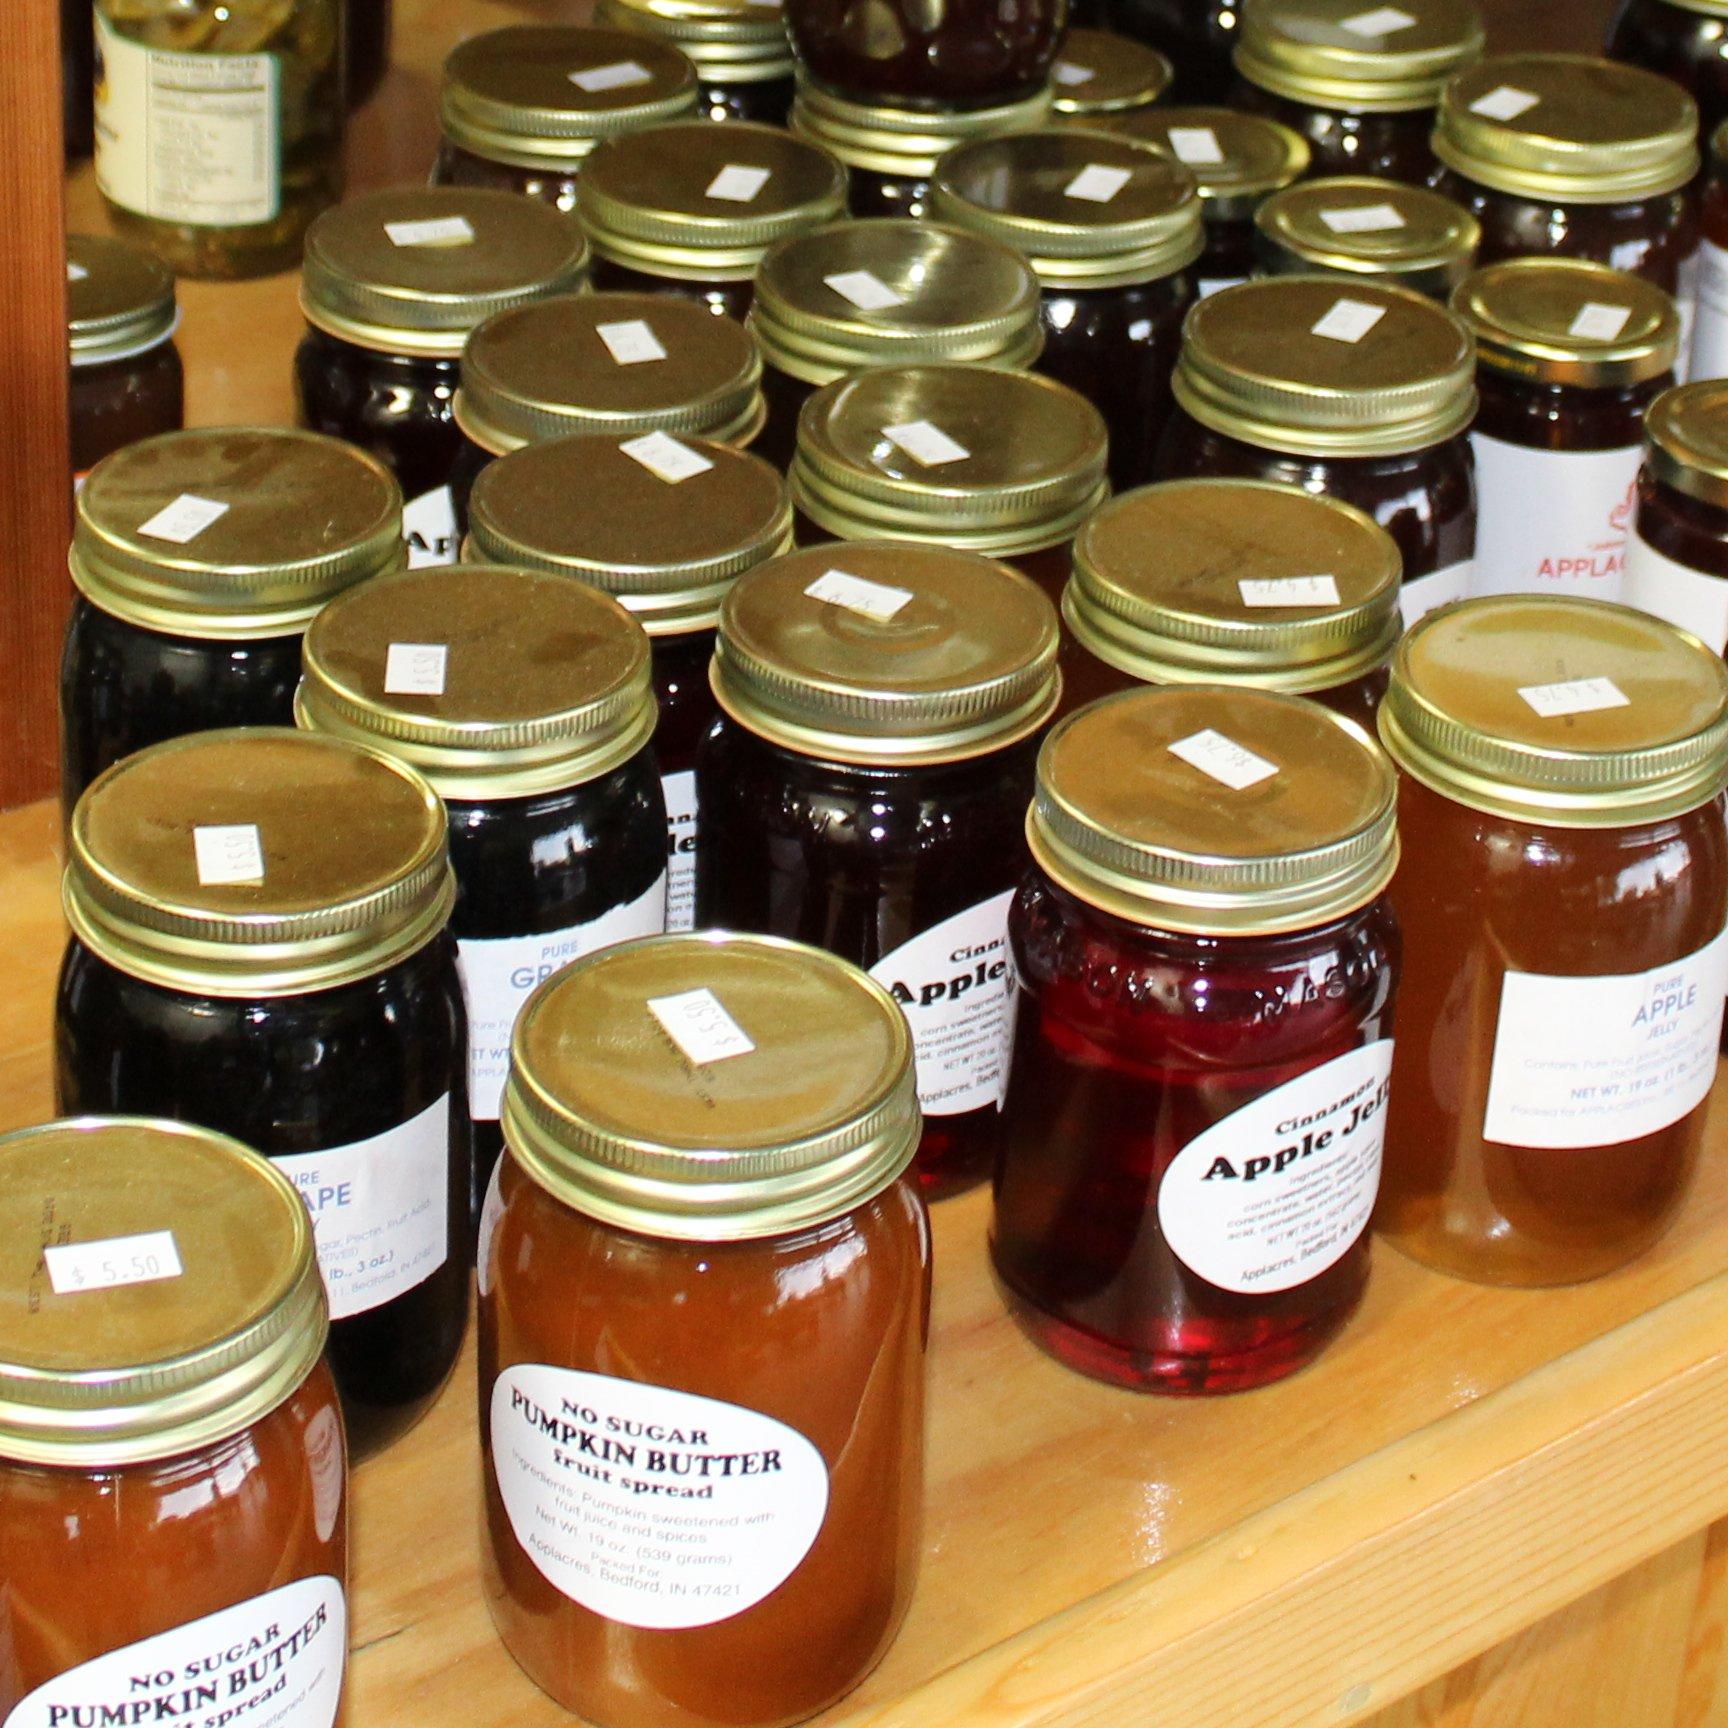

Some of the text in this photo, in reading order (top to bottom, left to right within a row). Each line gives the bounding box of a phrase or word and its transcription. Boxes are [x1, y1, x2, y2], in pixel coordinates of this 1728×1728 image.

[541, 939, 579, 961] PURE
[890, 959, 1007, 1007] Apple
[1631, 983, 1698, 1028] APPLE
[1653, 973, 1684, 994] PURE
[683, 999, 729, 1033] 5.50
[1647, 1019, 1680, 1041] JELLY
[1275, 1076, 1376, 1135] Cinnamon
[1570, 1087, 1596, 1101] NET
[1201, 1129, 1333, 1182] Apple
[1342, 1076, 1391, 1136] Jell
[292, 1170, 320, 1186] URE
[72, 1253, 161, 1286] $ 5.50
[357, 1260, 367, 1273] 3
[370, 1250, 395, 1268] oz.)
[510, 1384, 783, 1478] PUMPKIN BUTTER
[561, 1397, 709, 1447] NO SUGAR
[553, 1448, 714, 1501] fruit spread
[554, 1496, 708, 1546] fruit juice and spices
[581, 1489, 647, 1524] Pumpkin
[652, 1508, 739, 1529] sweetened
[744, 1510, 776, 1526] with
[535, 1504, 556, 1525] Net
[587, 1530, 605, 1548] 19
[636, 1546, 672, 1565] (539
[675, 1549, 733, 1570] grams)
[590, 1550, 636, 1576] Packed
[599, 1566, 665, 1597] Bedford,
[669, 1580, 687, 1596] IN
[691, 1583, 741, 1597] 47421
[47, 1678, 219, 1728] PUMPKIN
[228, 1601, 329, 1697] BUTTER
[129, 1621, 282, 1694] NO SUGAR
[203, 1672, 288, 1728] spread
